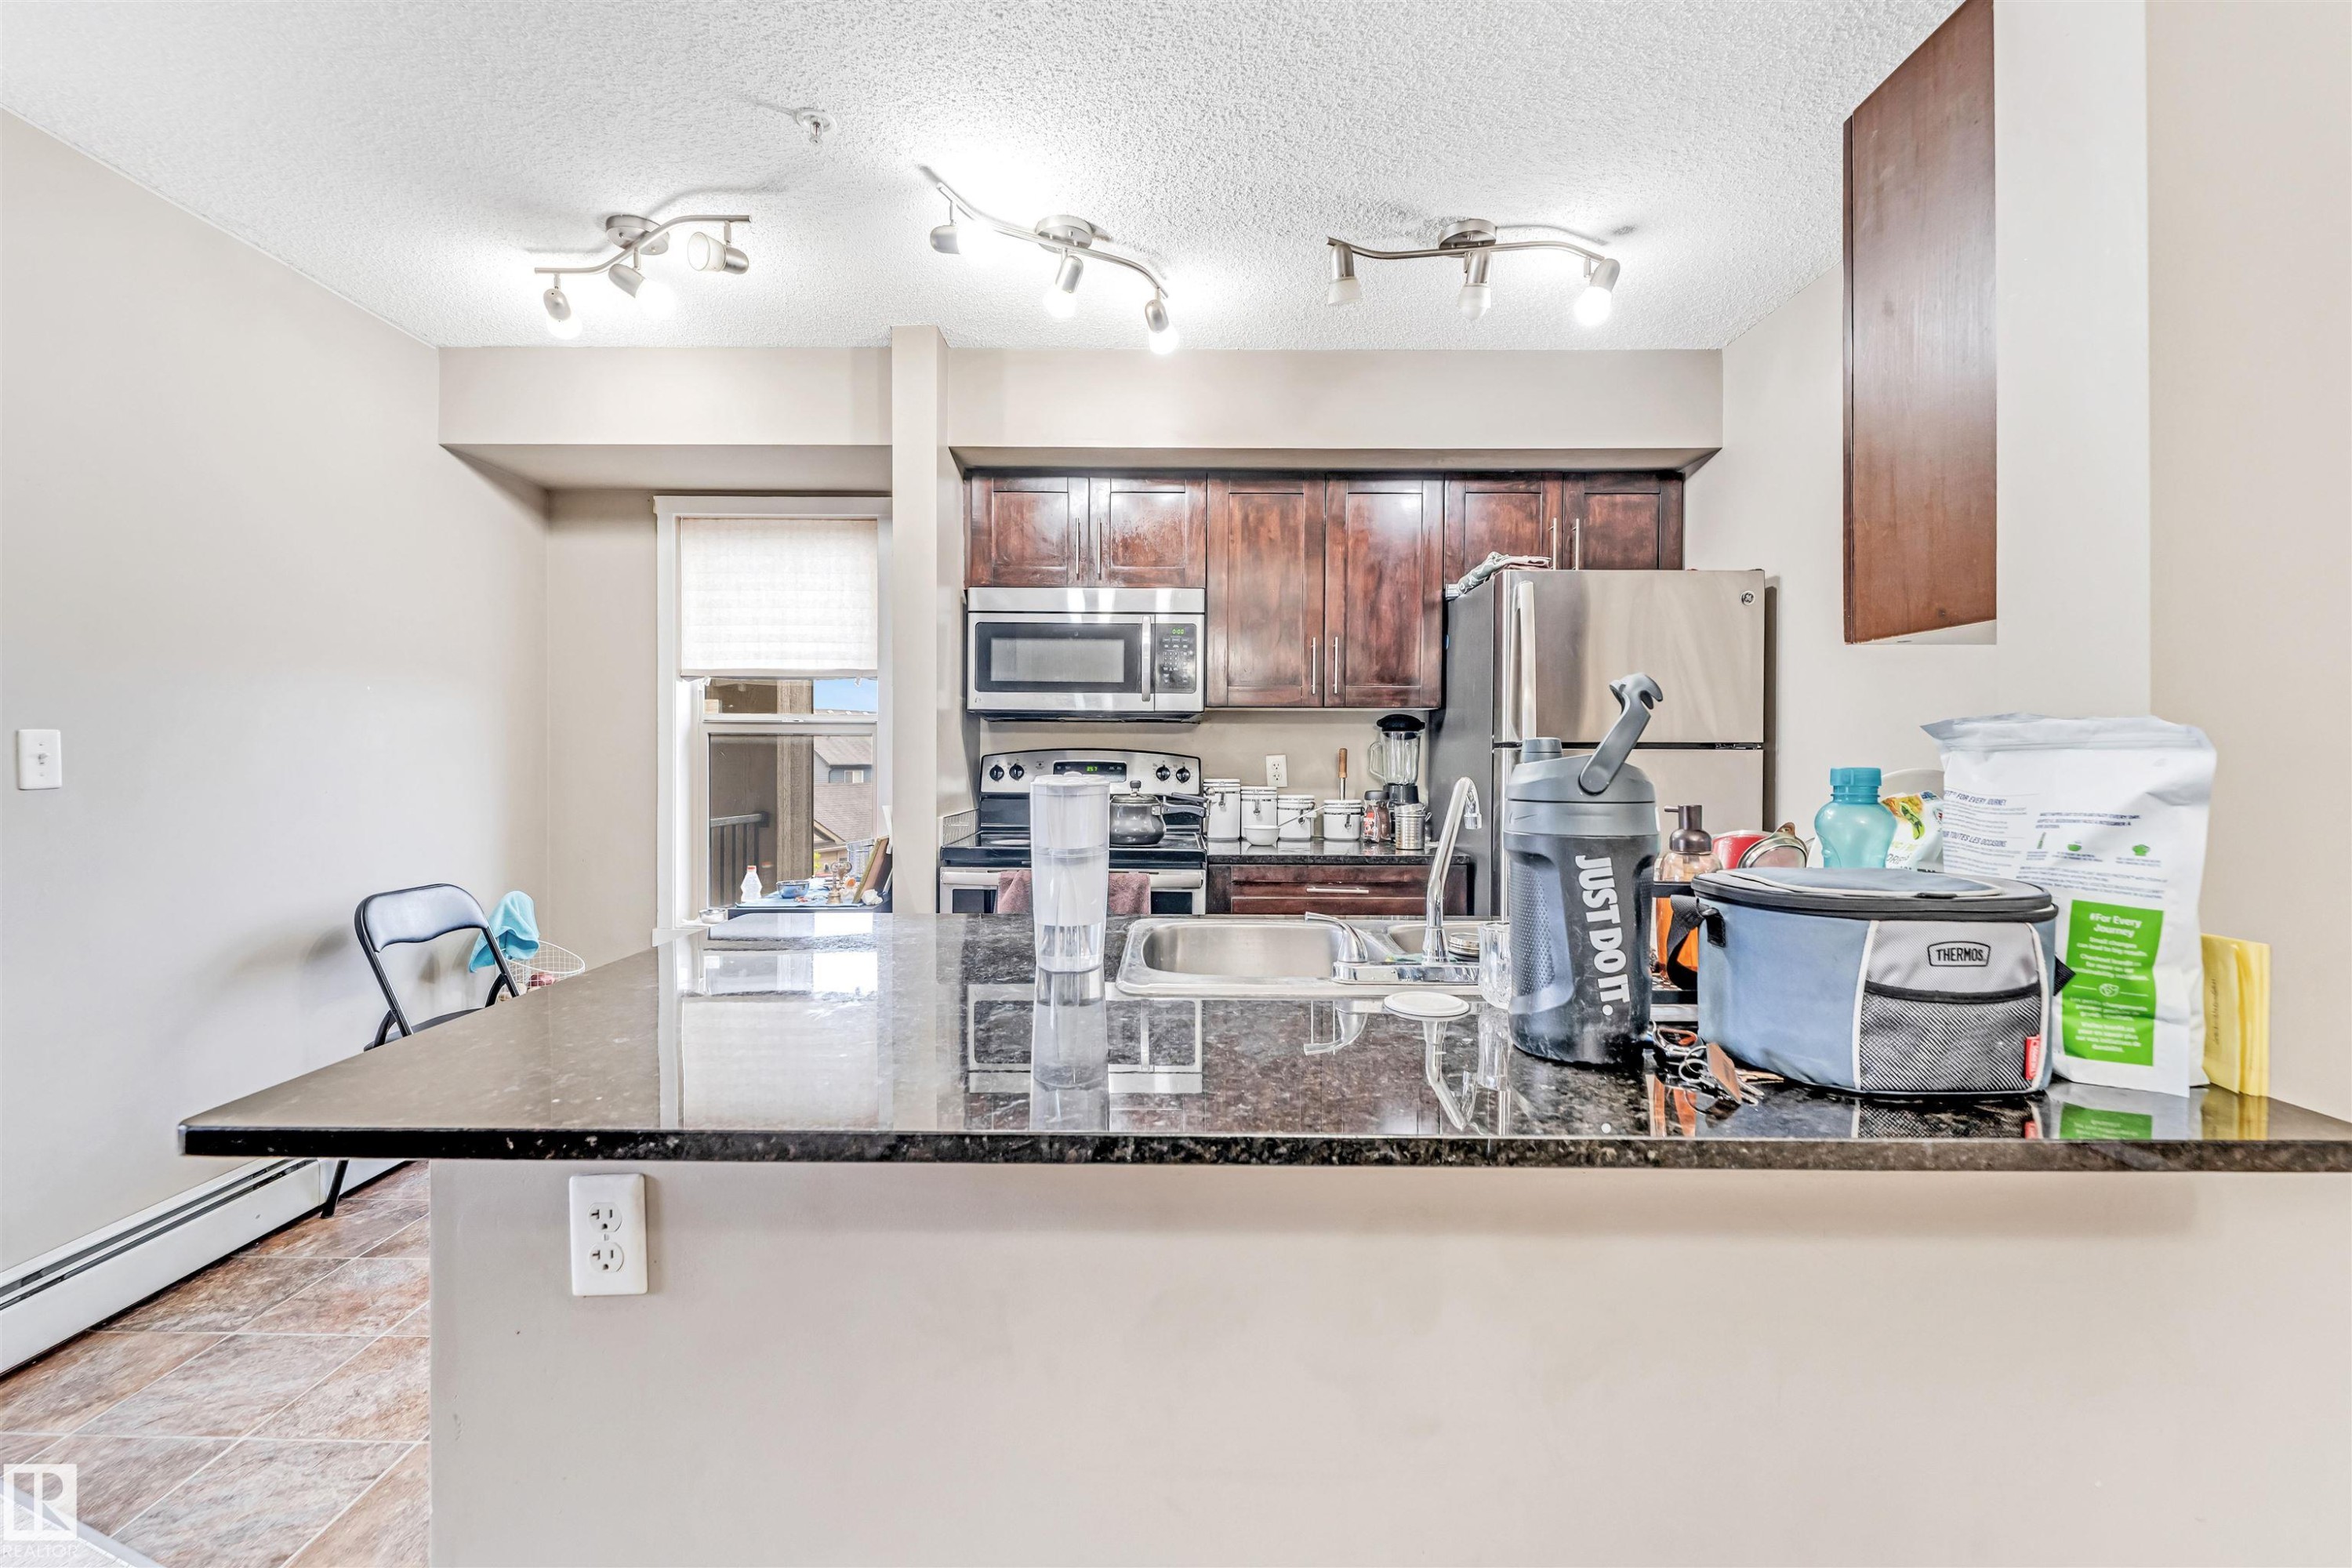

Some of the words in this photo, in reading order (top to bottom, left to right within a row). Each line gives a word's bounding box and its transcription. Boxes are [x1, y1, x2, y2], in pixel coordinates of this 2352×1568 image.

[1969, 836, 1981, 844] LES
[1575, 855, 1621, 924] JUST
[2093, 924, 2135, 938] Journey
[1589, 927, 1626, 974] DO
[1936, 947, 1984, 961] THERMOS
[1598, 974, 1630, 1016] IT.
